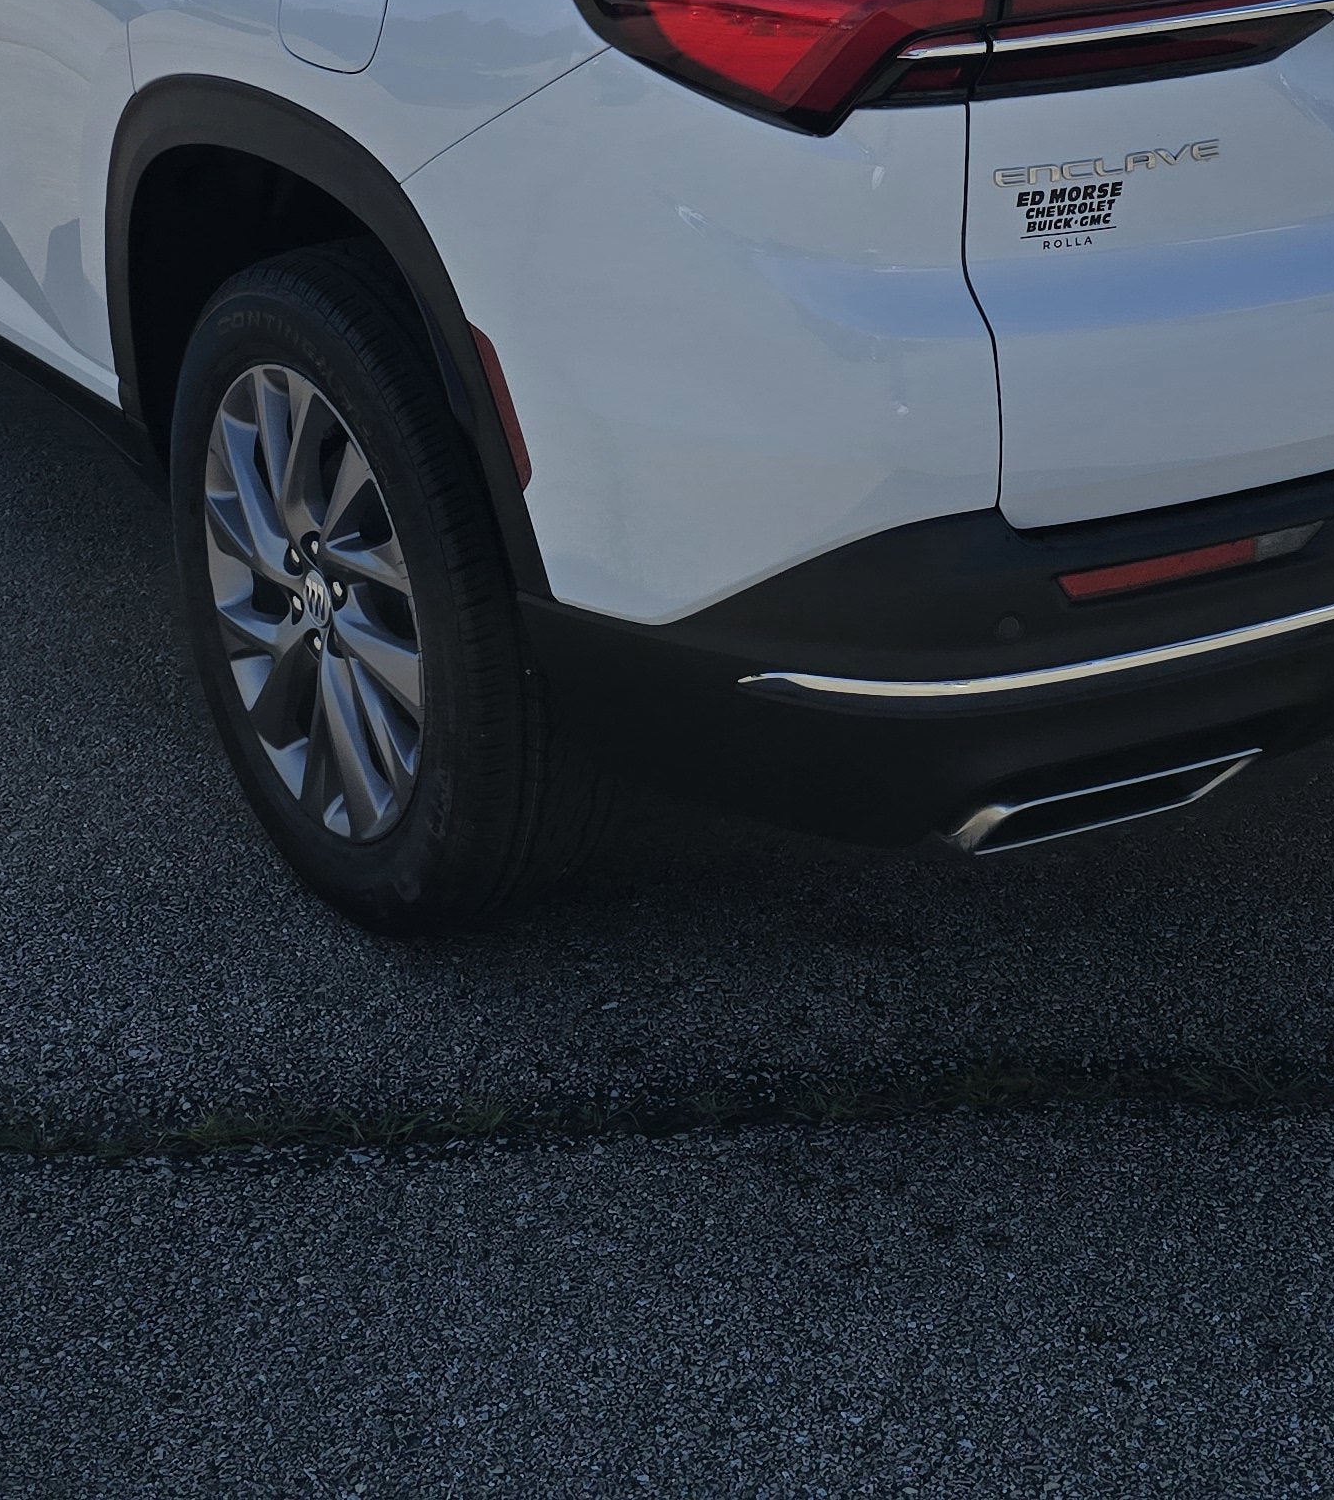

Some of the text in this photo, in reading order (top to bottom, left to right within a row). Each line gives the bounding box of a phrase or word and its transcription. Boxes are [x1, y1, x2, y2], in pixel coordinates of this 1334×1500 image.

[992, 138, 1220, 188] ENCLAVE
[1016, 181, 1124, 208] ED MORSE
[1025, 199, 1116, 220] CHEVROLET
[1043, 236, 1093, 250] ROLLA
